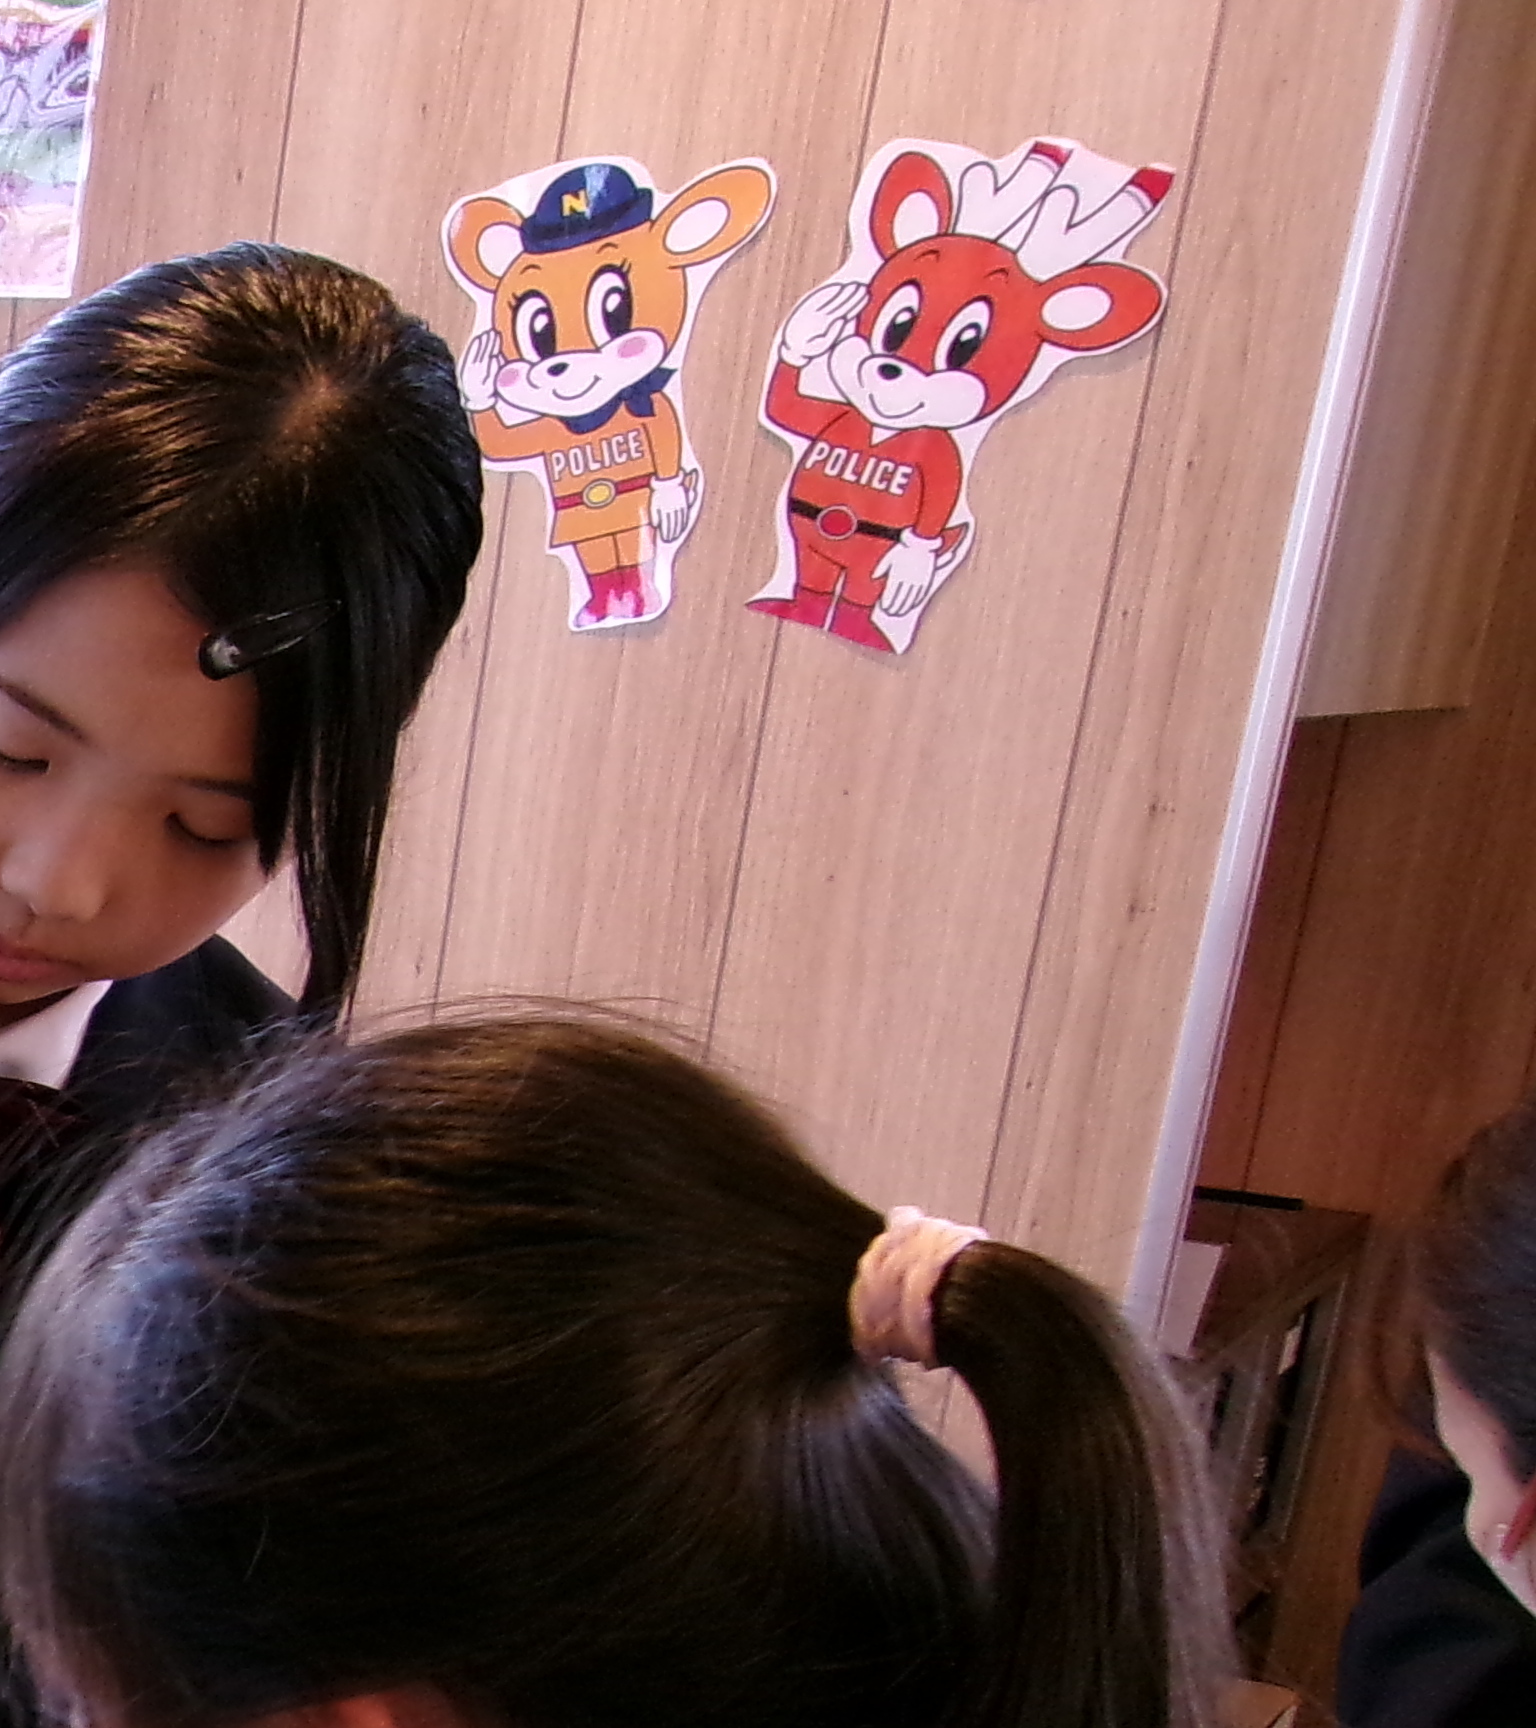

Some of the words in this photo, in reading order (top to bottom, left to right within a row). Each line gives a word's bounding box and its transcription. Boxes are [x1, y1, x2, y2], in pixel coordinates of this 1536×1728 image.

[561, 188, 591, 219] N
[550, 430, 645, 482] POLICE
[804, 440, 914, 496] POLICE
